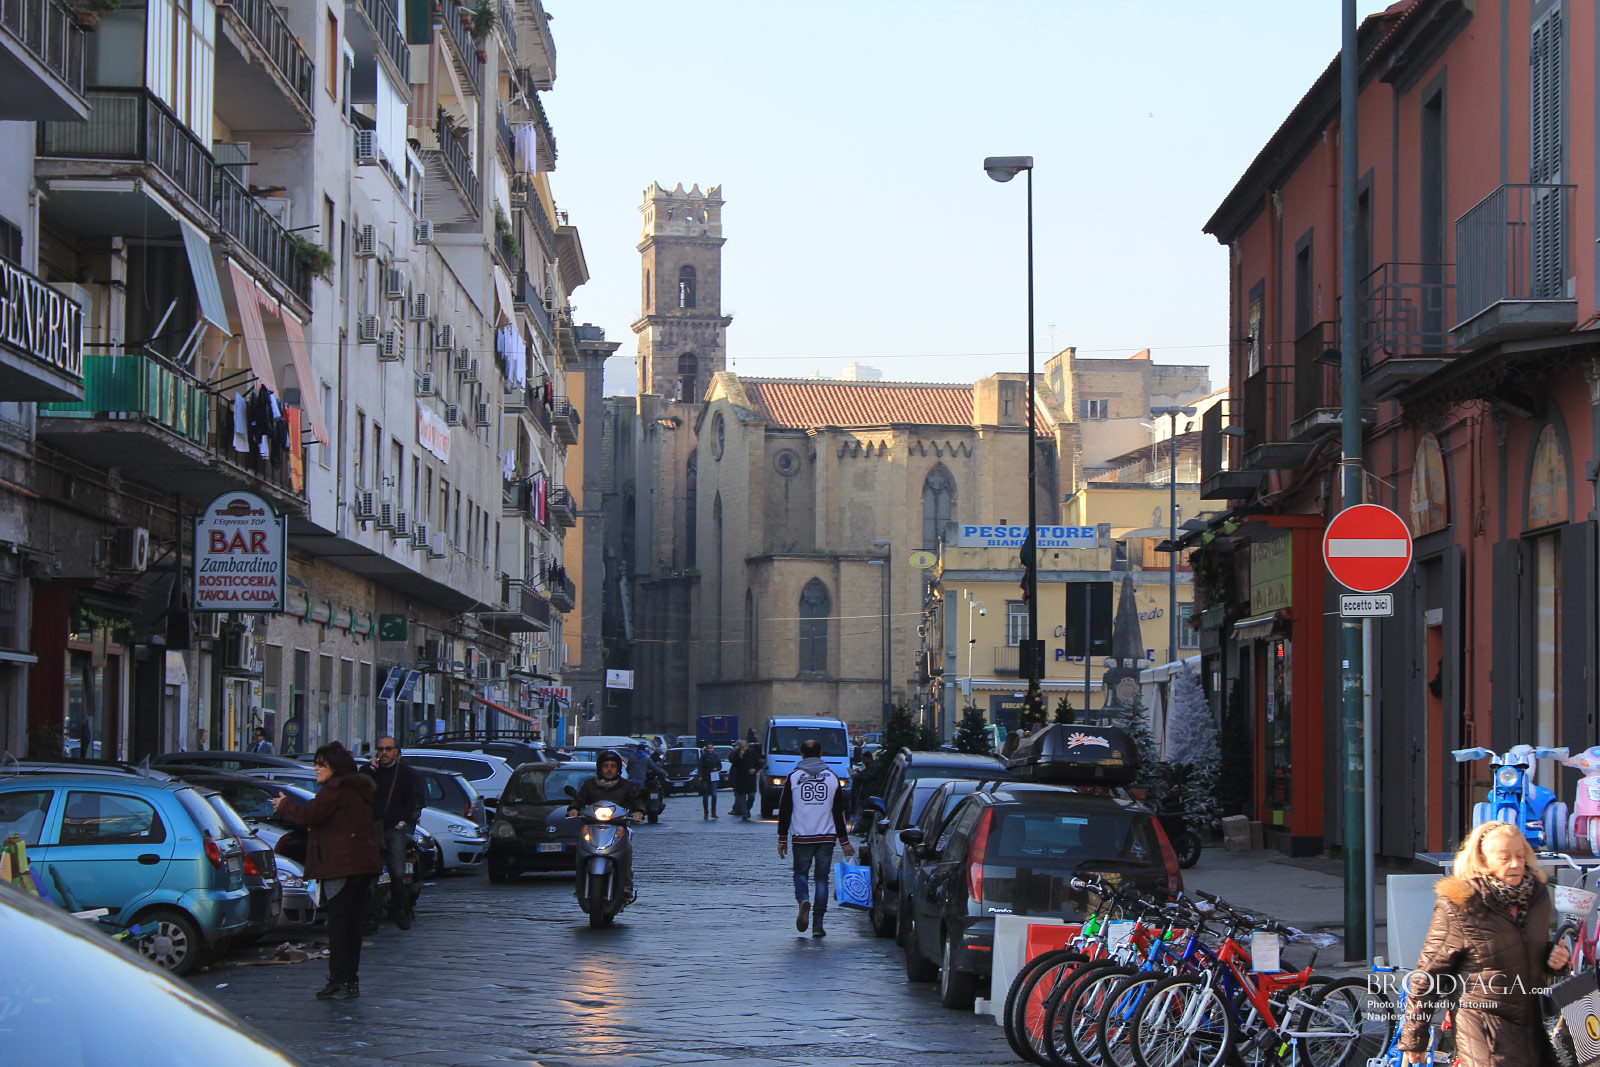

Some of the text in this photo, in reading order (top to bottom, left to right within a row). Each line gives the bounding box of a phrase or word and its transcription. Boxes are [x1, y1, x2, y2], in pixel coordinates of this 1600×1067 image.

[213, 518, 248, 526] L'Espresso
[208, 528, 270, 554] BAR
[200, 557, 277, 573] Zambardino
[198, 575, 277, 587] ROSTICCERIA
[198, 589, 277, 601] TAVOLA CALDA
[1344, 598, 1388, 611] eccetto bici
[800, 782, 829, 801] 69
